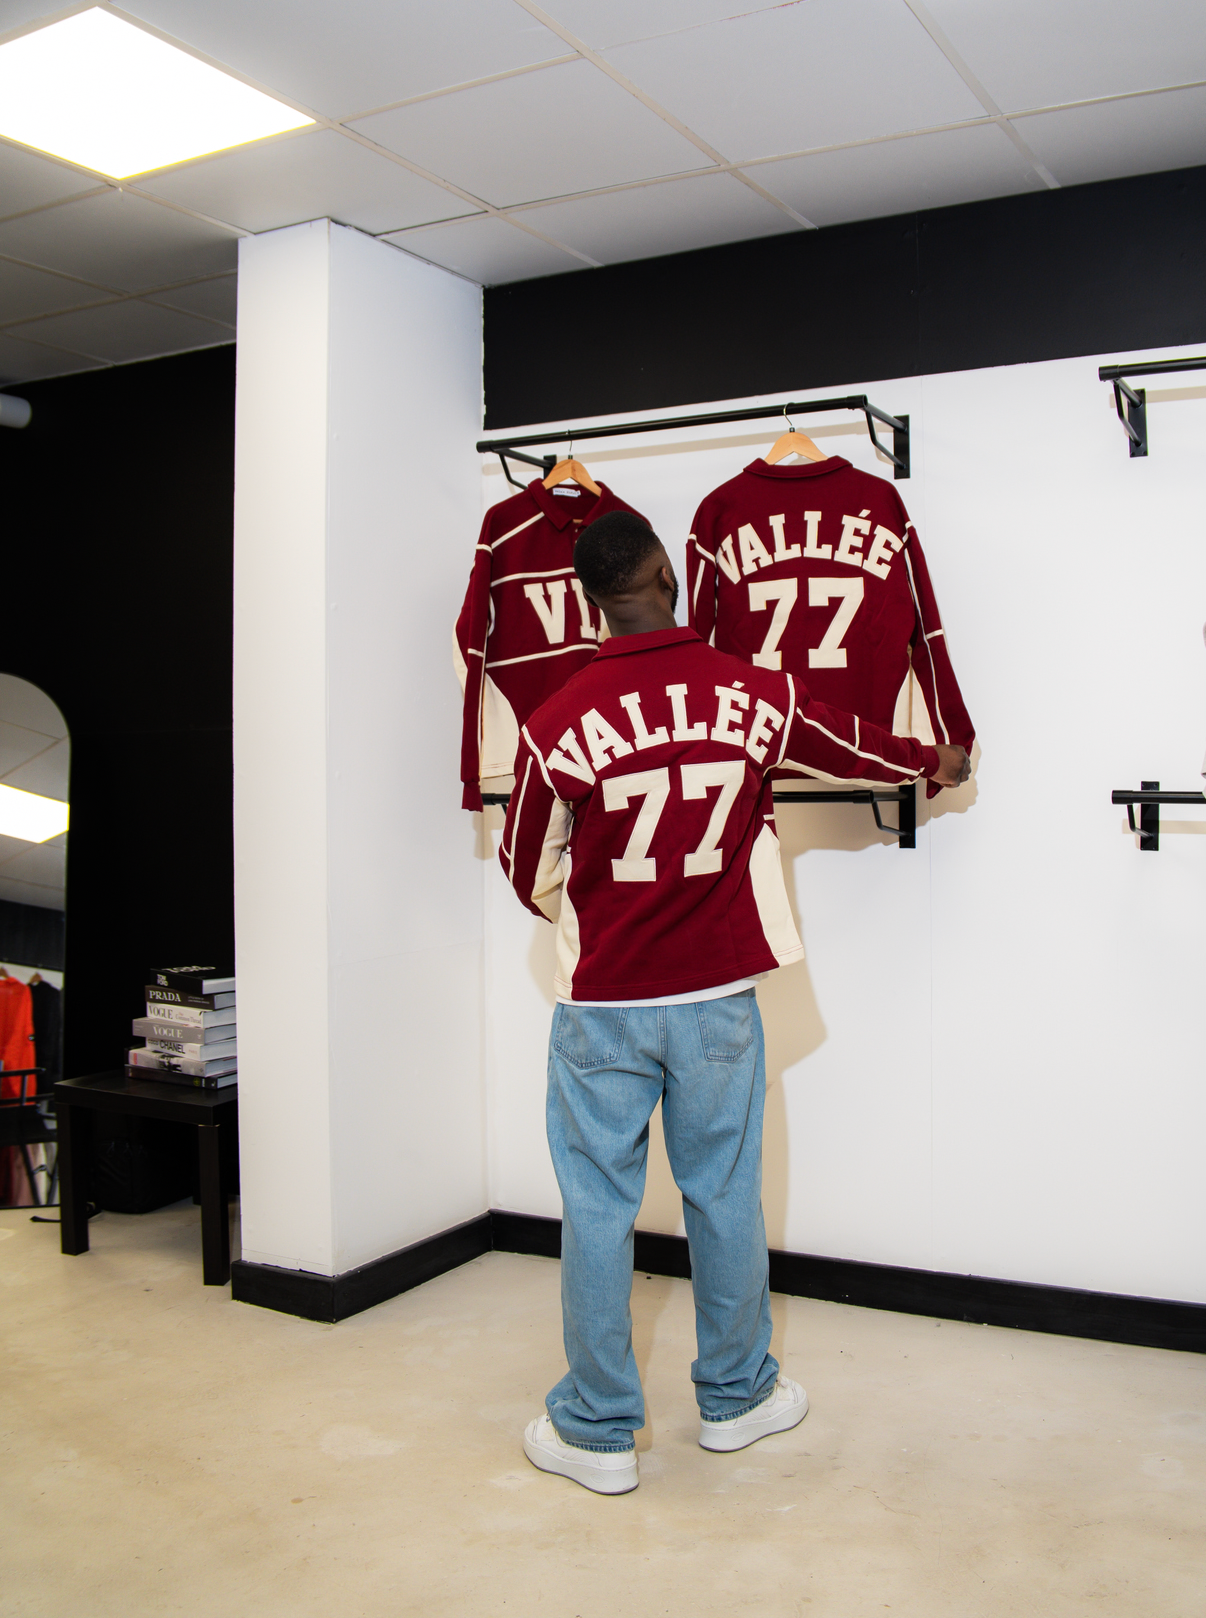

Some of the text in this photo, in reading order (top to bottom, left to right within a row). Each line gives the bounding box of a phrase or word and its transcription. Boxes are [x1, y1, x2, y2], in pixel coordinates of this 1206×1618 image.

[715, 509, 903, 584] VALLÉE
[747, 576, 866, 670] 77
[545, 680, 786, 786] VALLÉE
[602, 759, 747, 882] 77
[148, 1005, 174, 1020] VOGUE
[149, 989, 182, 1003] PRADA
[153, 1024, 183, 1039] VOGUE
[160, 1039, 186, 1055] CHANEL
